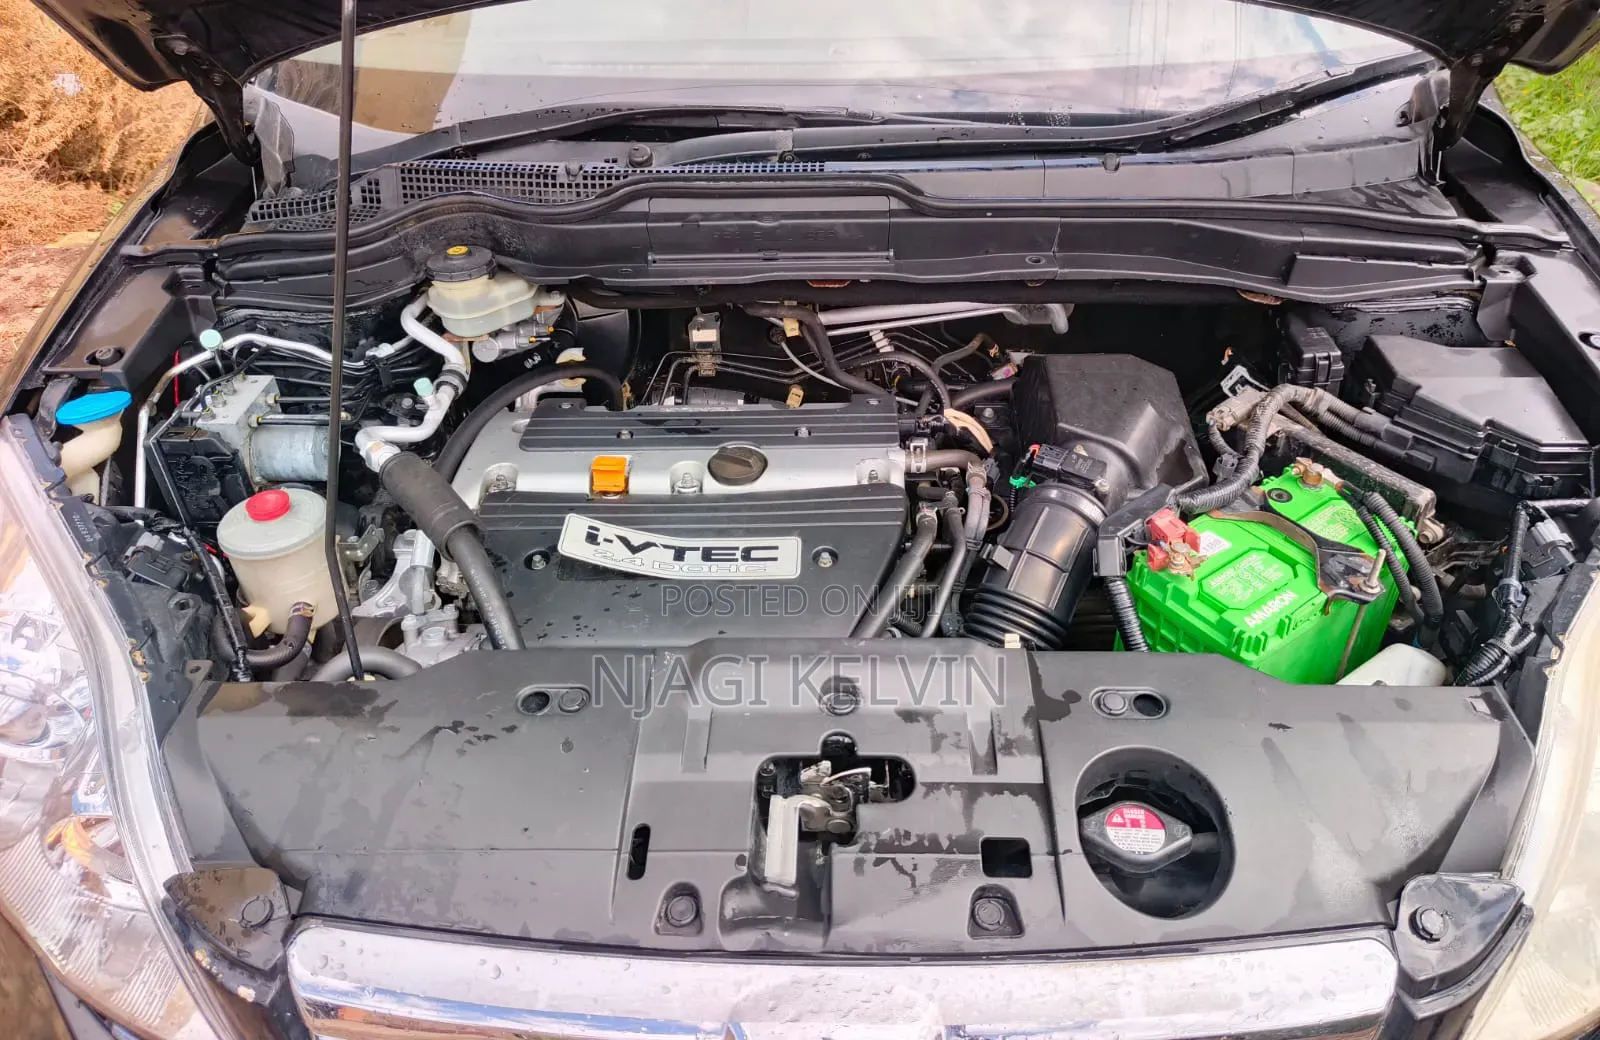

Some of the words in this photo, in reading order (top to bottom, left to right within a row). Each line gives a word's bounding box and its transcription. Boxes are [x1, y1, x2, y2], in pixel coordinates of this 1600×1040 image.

[584, 525, 779, 563] i-VTEC
[593, 548, 645, 567] 2.4
[652, 561, 767, 574] DOHC
[1244, 590, 1299, 628] AMARON
